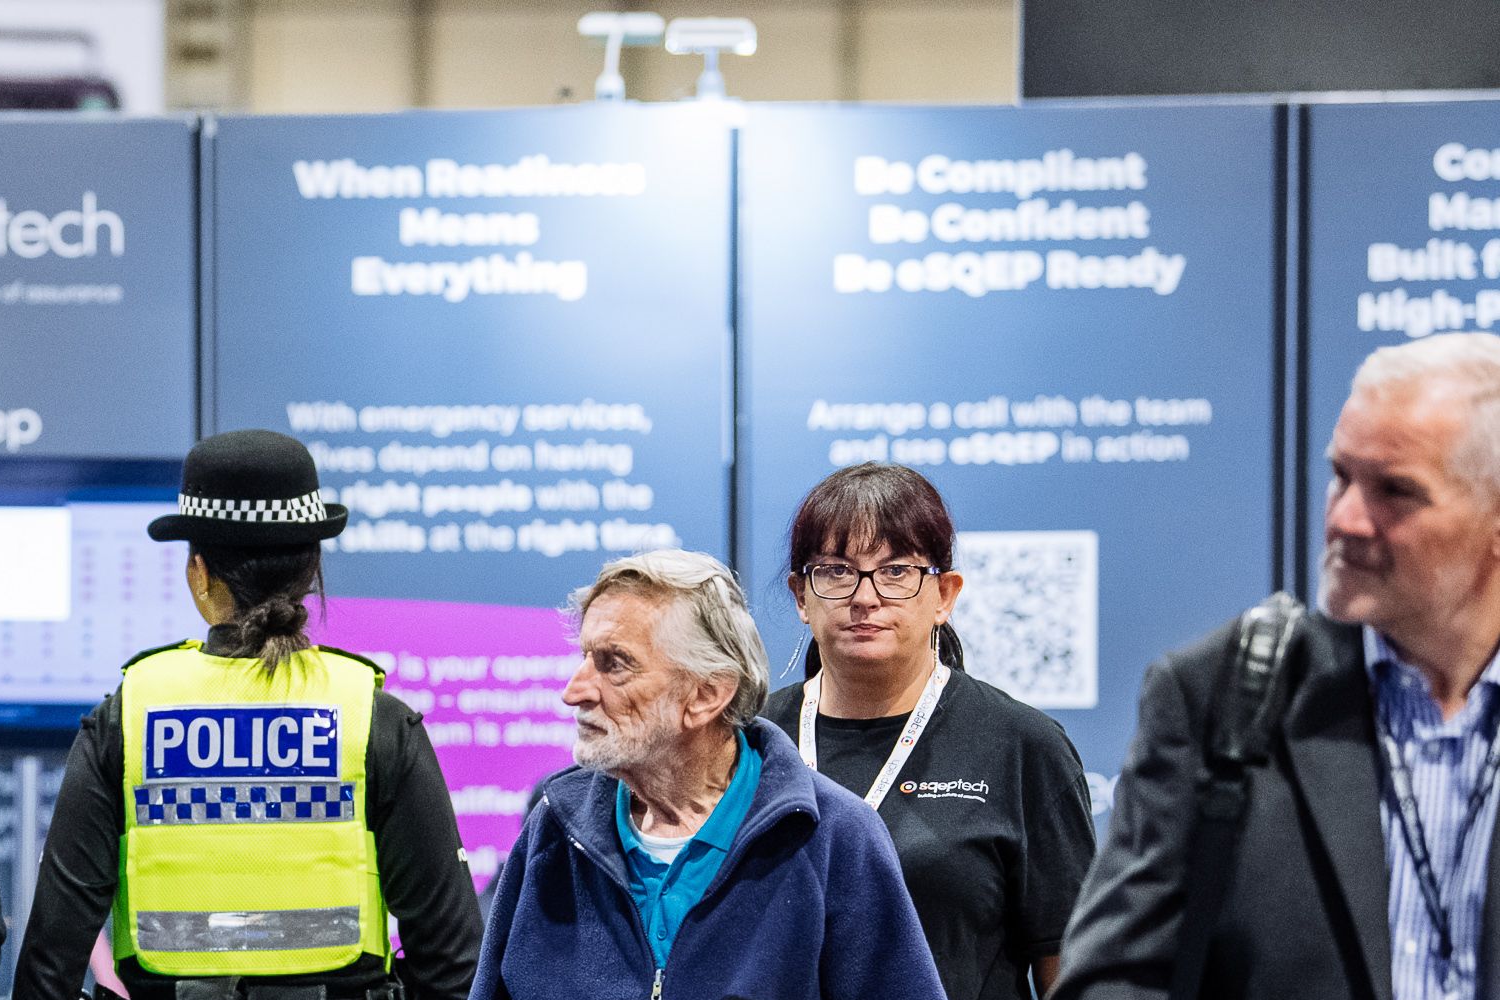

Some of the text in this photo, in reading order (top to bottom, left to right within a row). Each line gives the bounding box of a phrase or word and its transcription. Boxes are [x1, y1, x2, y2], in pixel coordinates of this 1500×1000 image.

[294, 158, 423, 198] When
[855, 149, 1148, 199] Be Compliant
[400, 207, 539, 247] Means
[869, 201, 1150, 243] Be Confident
[352, 251, 588, 302] Everything
[833, 248, 1186, 298] Be eSQEP Ready
[1367, 238, 1478, 282] Built
[806, 398, 927, 435] Arrange
[152, 715, 332, 769] POLICE
[918, 778, 990, 796] sqeptech
